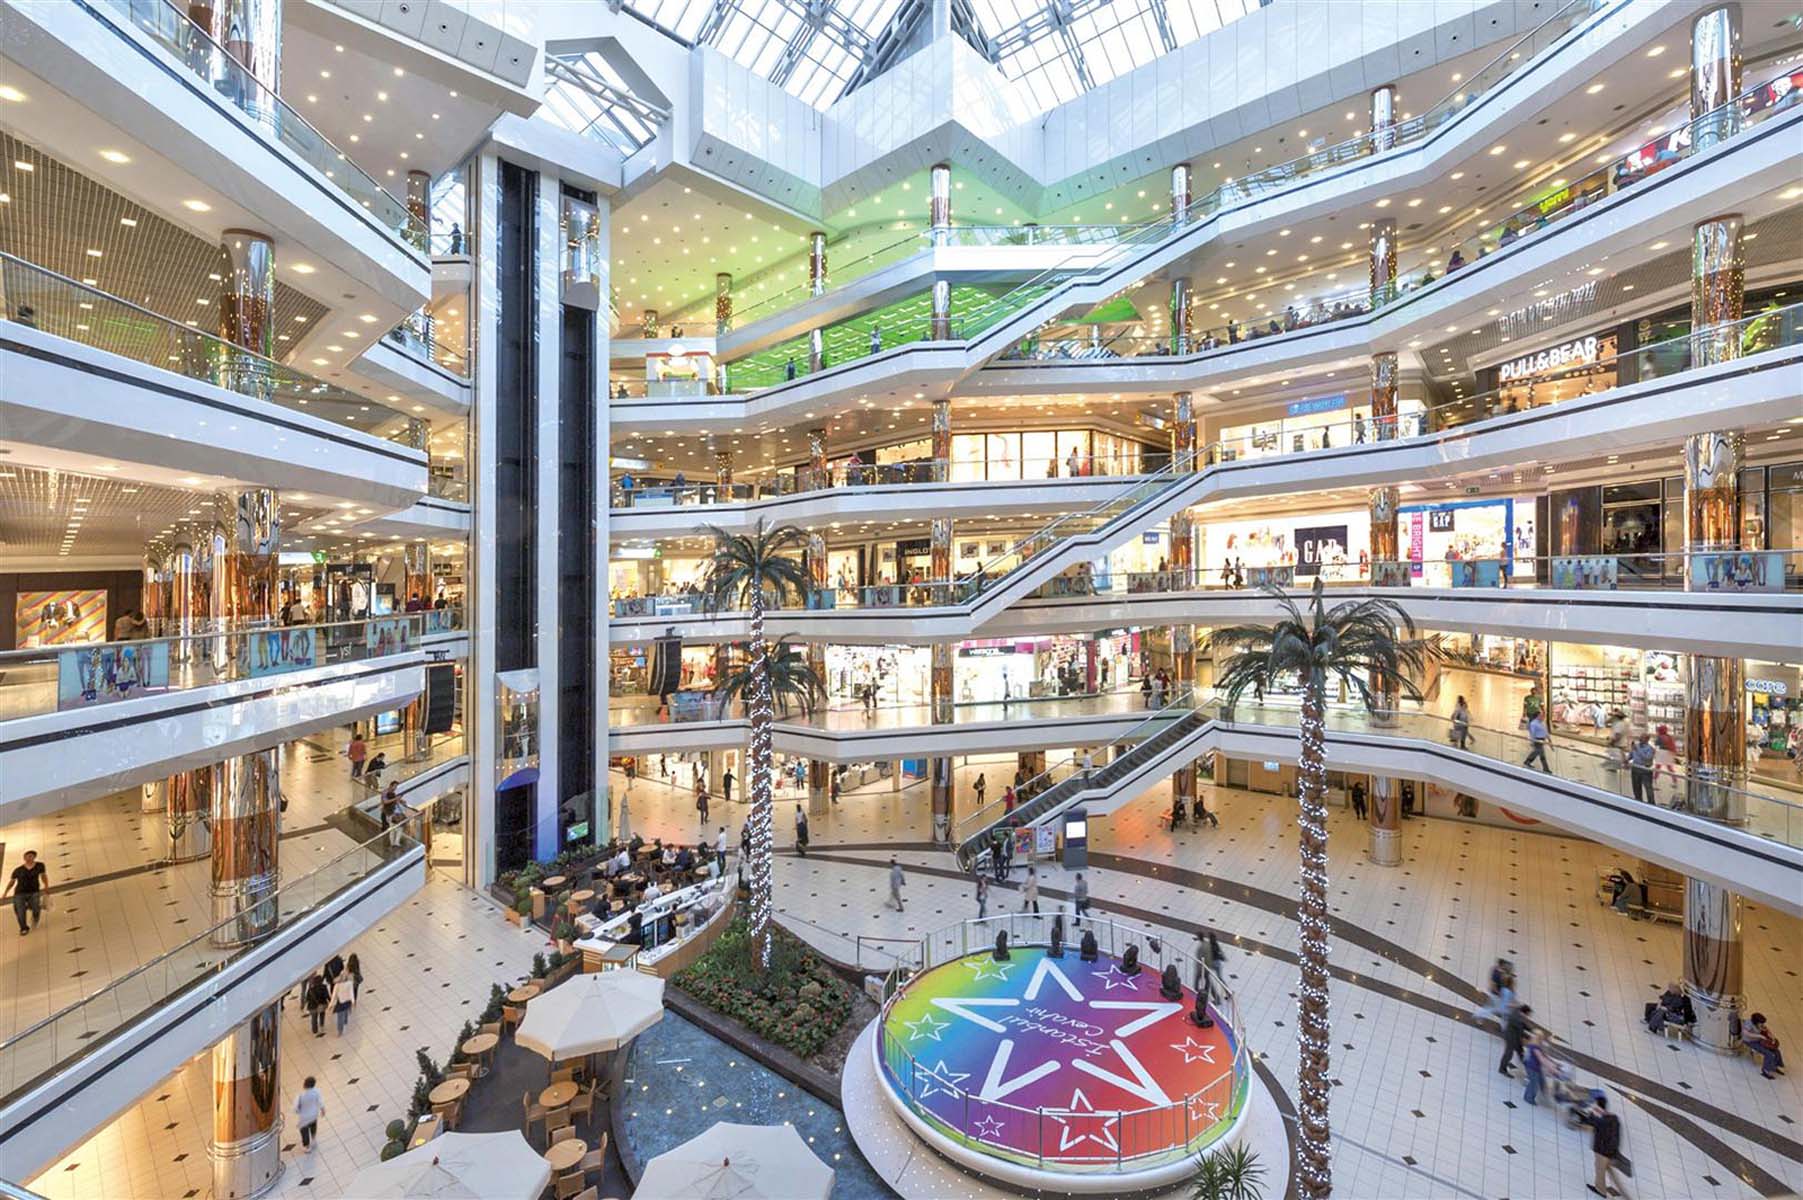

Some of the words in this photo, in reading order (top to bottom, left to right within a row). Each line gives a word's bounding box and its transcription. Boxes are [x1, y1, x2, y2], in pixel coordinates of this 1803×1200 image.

[1501, 336, 1598, 379] PULL&BEAR
[905, 547, 929, 556] INGLO
[1304, 538, 1337, 563] GAP
[1412, 524, 1422, 558] BRIGHT
[1025, 1007, 1104, 1037] Cevahir
